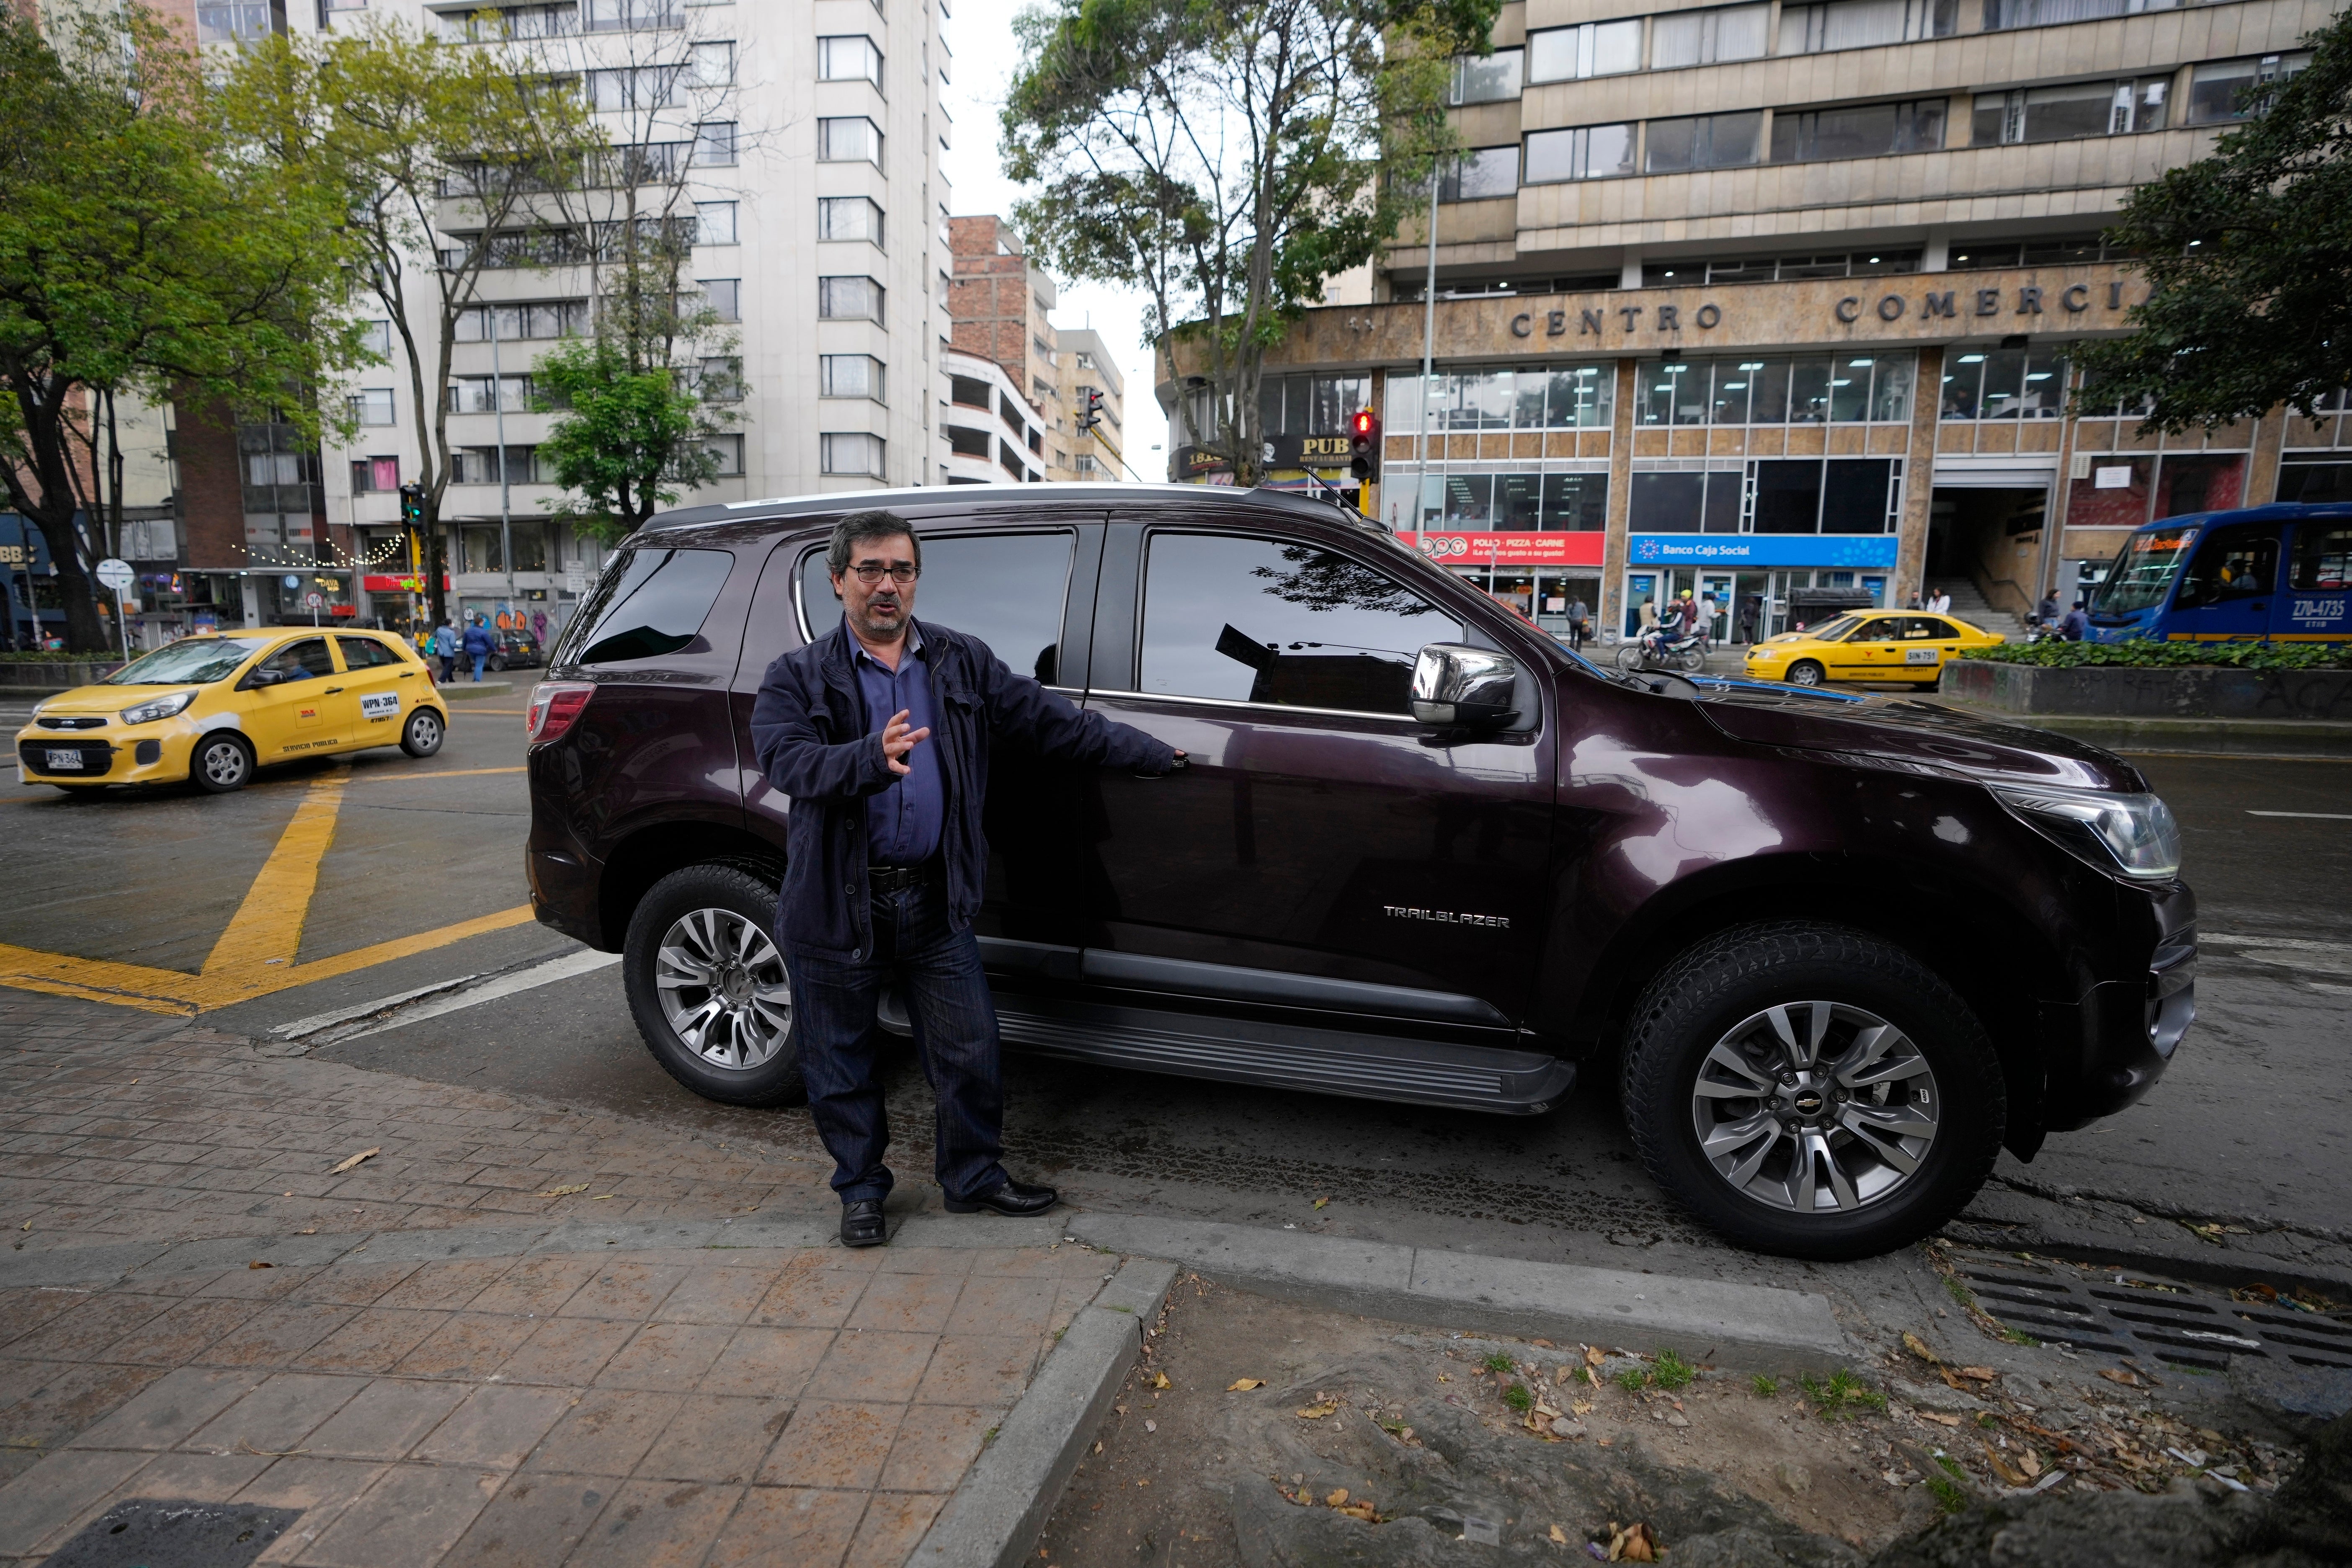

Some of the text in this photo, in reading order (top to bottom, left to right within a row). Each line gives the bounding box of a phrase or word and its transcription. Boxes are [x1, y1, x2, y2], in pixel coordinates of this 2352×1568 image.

[1511, 304, 1721, 337] CENTRO
[1302, 438, 1349, 455] PUB
[1506, 539, 1531, 547] PIZZA
[1535, 539, 1565, 547] CARNE
[1663, 544, 1750, 557] Banco Caja Social
[1542, 549, 1565, 557] gusto!
[2292, 600, 2346, 616] Z70-4735
[282, 739, 338, 753] SERVICIO PUBLICO
[1384, 906, 1510, 928] TRAILBLAZER
